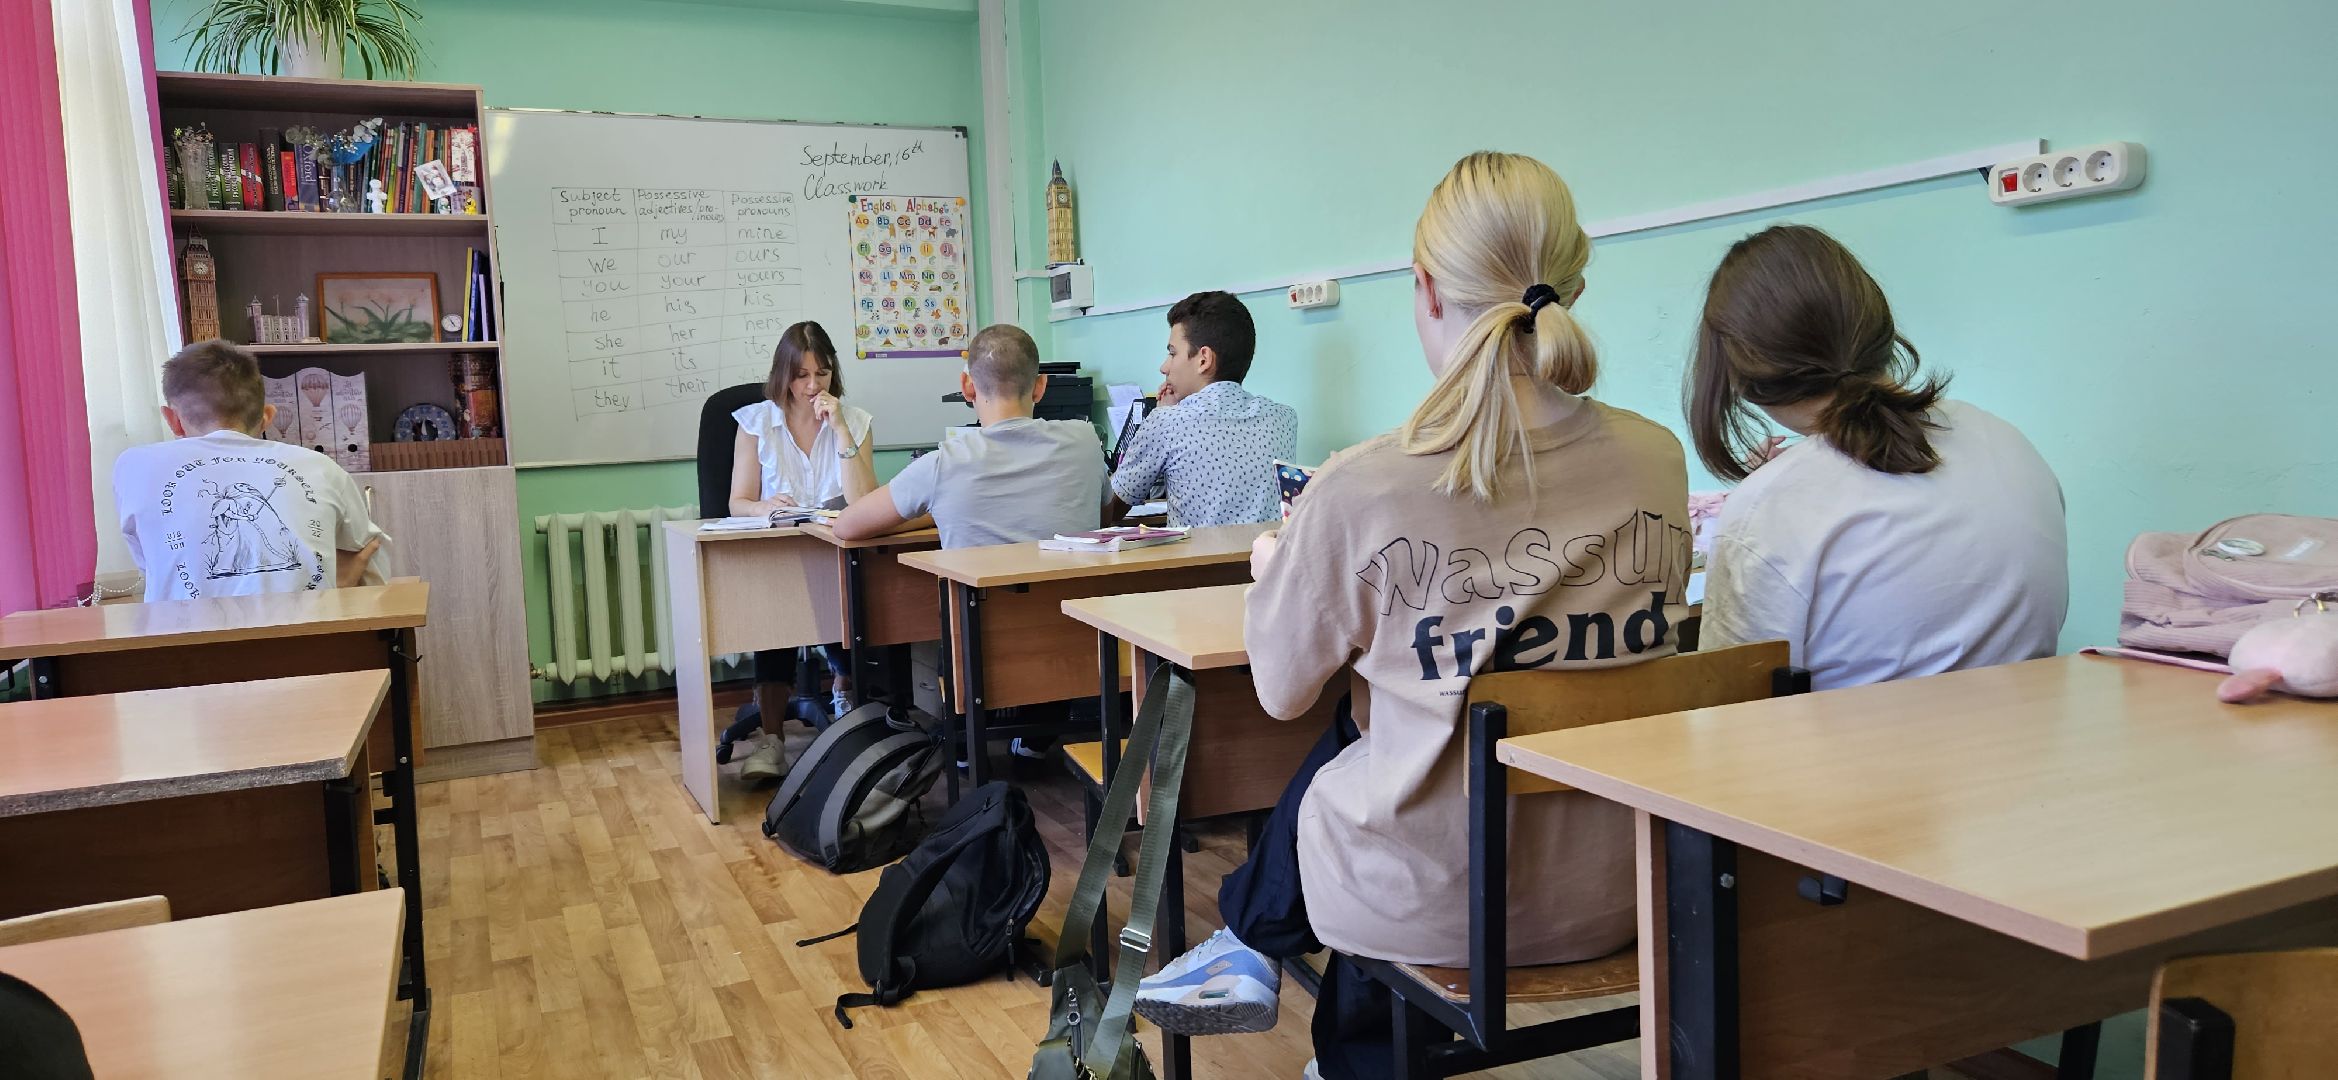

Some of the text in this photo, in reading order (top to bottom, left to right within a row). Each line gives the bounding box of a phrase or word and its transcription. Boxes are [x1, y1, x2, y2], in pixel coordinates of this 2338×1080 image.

[303, 144, 317, 182] Oxford
[560, 188, 621, 206] Subject
[637, 188, 711, 200] Possessive
[569, 207, 626, 223] pronoun
[737, 207, 791, 220] pronouns
[860, 197, 950, 216] English Alphabet
[855, 216, 952, 227] Aa Bb Cc Dd Ee
[592, 226, 608, 244] I
[661, 227, 687, 245] my
[738, 227, 788, 239] mine
[736, 248, 780, 262] ours
[879, 244, 892, 255] Gg
[658, 252, 697, 268] our
[661, 274, 706, 289] your
[737, 270, 785, 286] yours
[859, 271, 956, 280] Kk Ll Mm Nn Oo
[582, 280, 631, 297] you
[744, 288, 774, 307] his
[861, 299, 874, 310] Pp
[881, 299, 895, 309] Qq
[924, 299, 935, 308] Ss
[591, 303, 611, 322] he
[744, 316, 783, 331] hers
[857, 325, 961, 336] Uu Vv Ww Xx Yy Zz
[594, 333, 624, 350] she
[668, 323, 697, 343] her
[744, 336, 770, 359] its
[671, 347, 697, 371] its
[602, 358, 621, 378] it
[665, 376, 711, 398] their
[594, 389, 630, 412] they
[1411, 591, 1670, 681] friend
